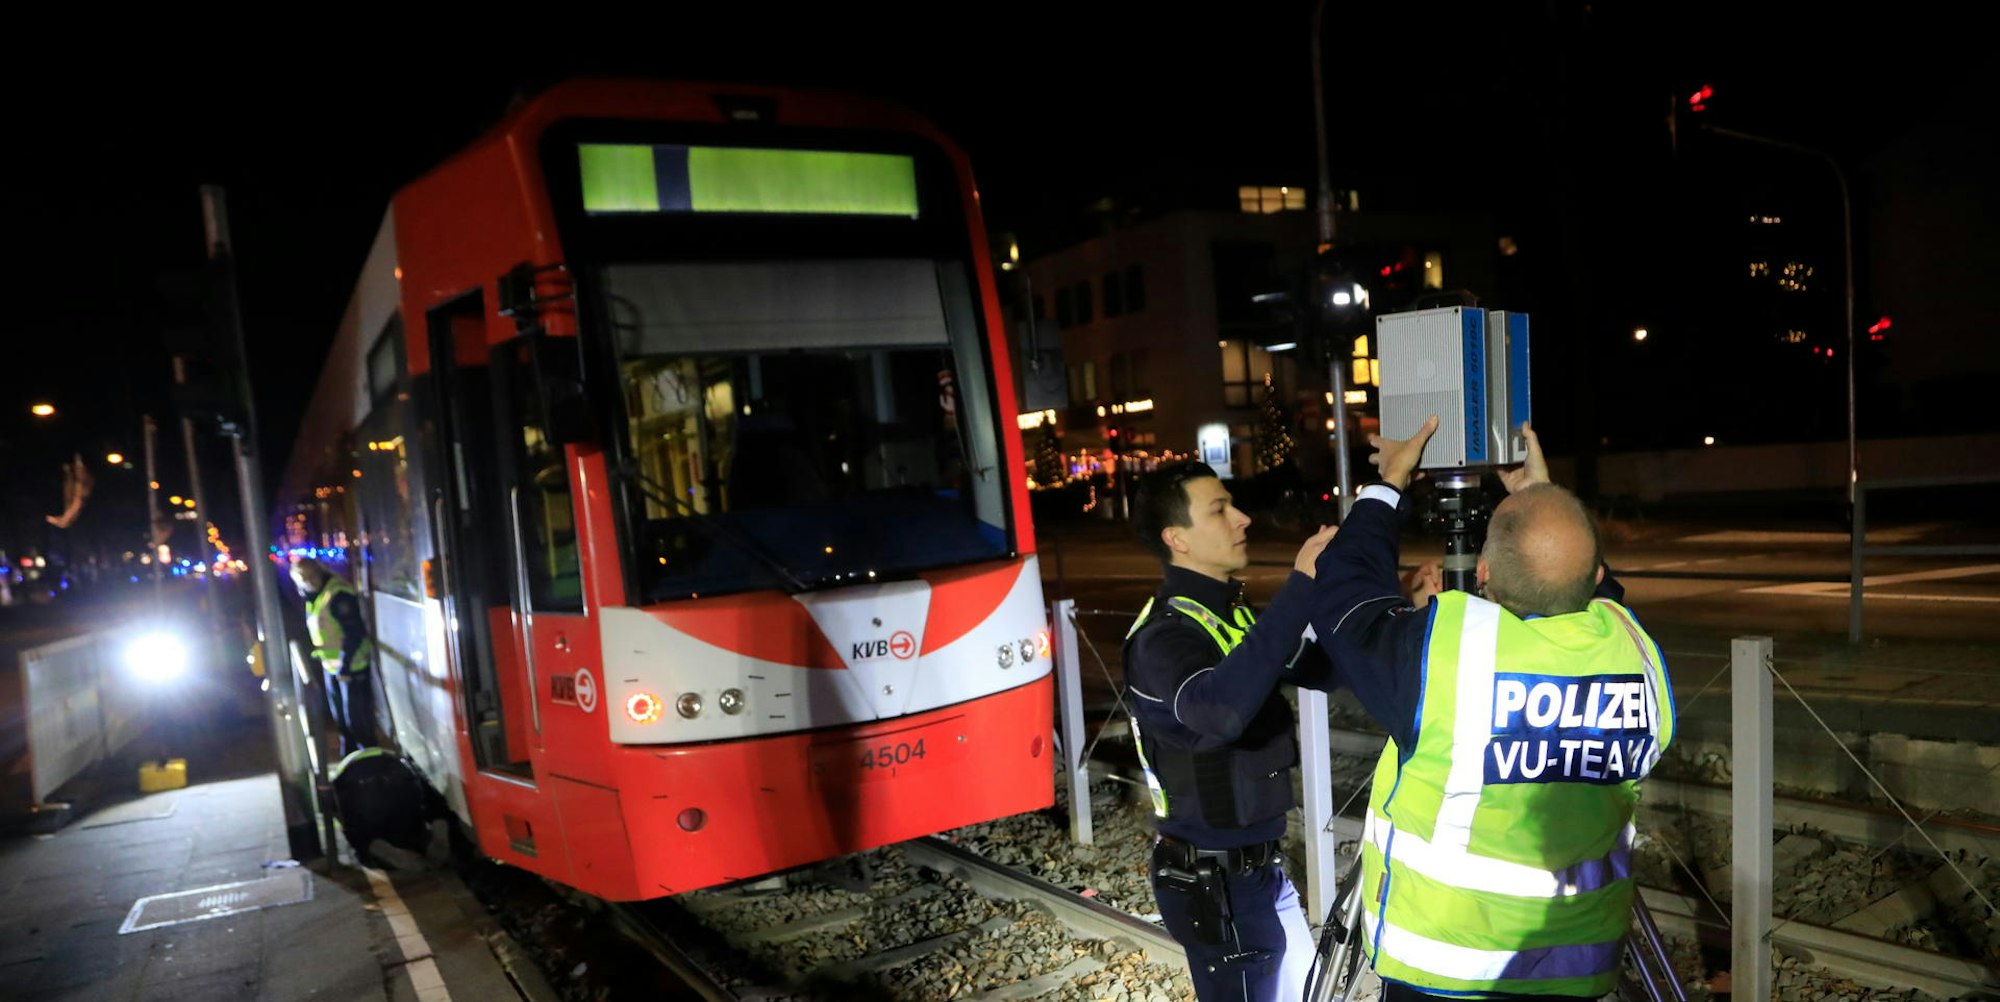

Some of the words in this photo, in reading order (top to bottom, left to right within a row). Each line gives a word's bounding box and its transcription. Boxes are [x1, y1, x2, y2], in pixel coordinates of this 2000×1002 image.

[1471, 380, 1481, 453] IMAGER
[852, 640, 888, 660] KVB
[551, 675, 576, 700] KVB
[862, 739, 926, 770] 4504
